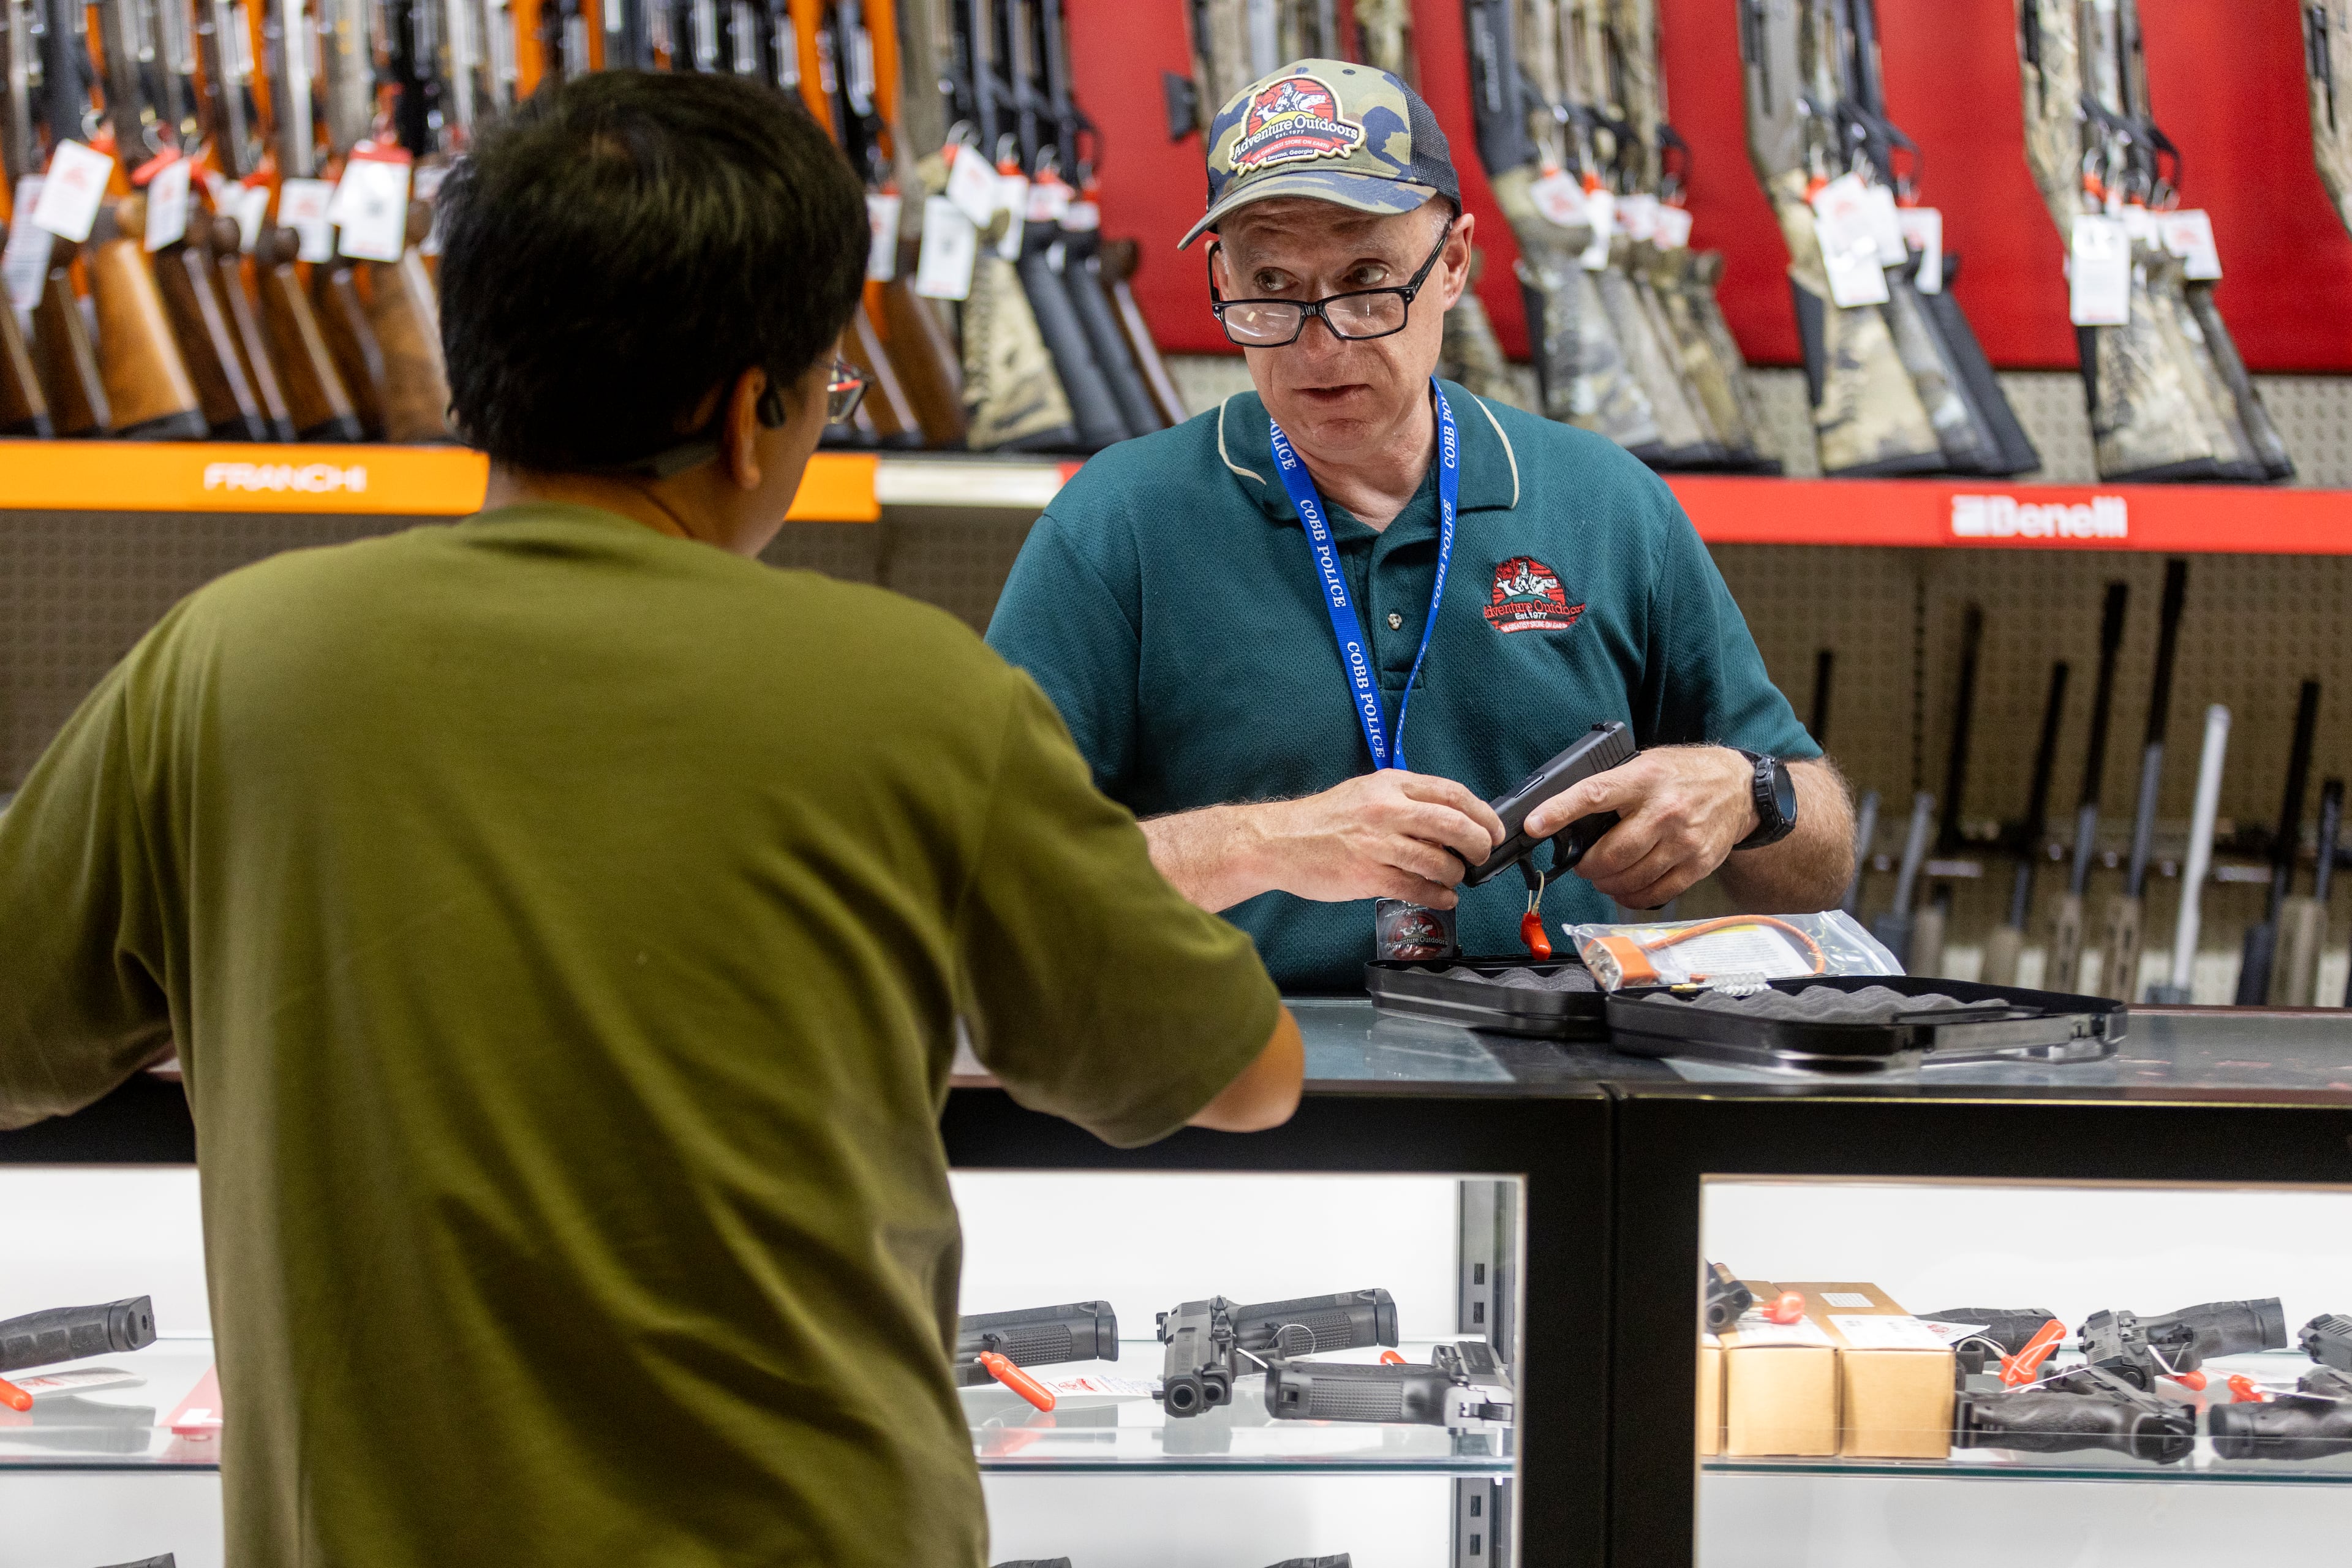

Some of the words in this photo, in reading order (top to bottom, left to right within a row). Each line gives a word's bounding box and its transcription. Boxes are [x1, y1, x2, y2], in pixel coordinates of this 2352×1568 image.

[1234, 120, 1293, 160] Adventure
[1294, 115, 1359, 140] Outdoors
[1252, 154, 1261, 162] THE
[1261, 141, 1284, 156] GREATEST
[1284, 138, 1302, 146] STORE
[1312, 140, 1330, 149] EARTH
[1267, 151, 1289, 162] Smyrna,
[1270, 418, 1297, 470] OLICE
[1443, 426, 1455, 469] COBB
[203, 462, 368, 493] FRANCHI
[1300, 499, 1327, 541] COBB
[1317, 545, 1346, 608] POLICE
[1433, 562, 1446, 609] COBB
[1441, 499, 1453, 562] POLICE
[1483, 601, 1534, 619] Adventure
[1347, 641, 1370, 689] COBB
[1360, 692, 1386, 758] POLICE
[1419, 936, 1449, 945] Outdoors
